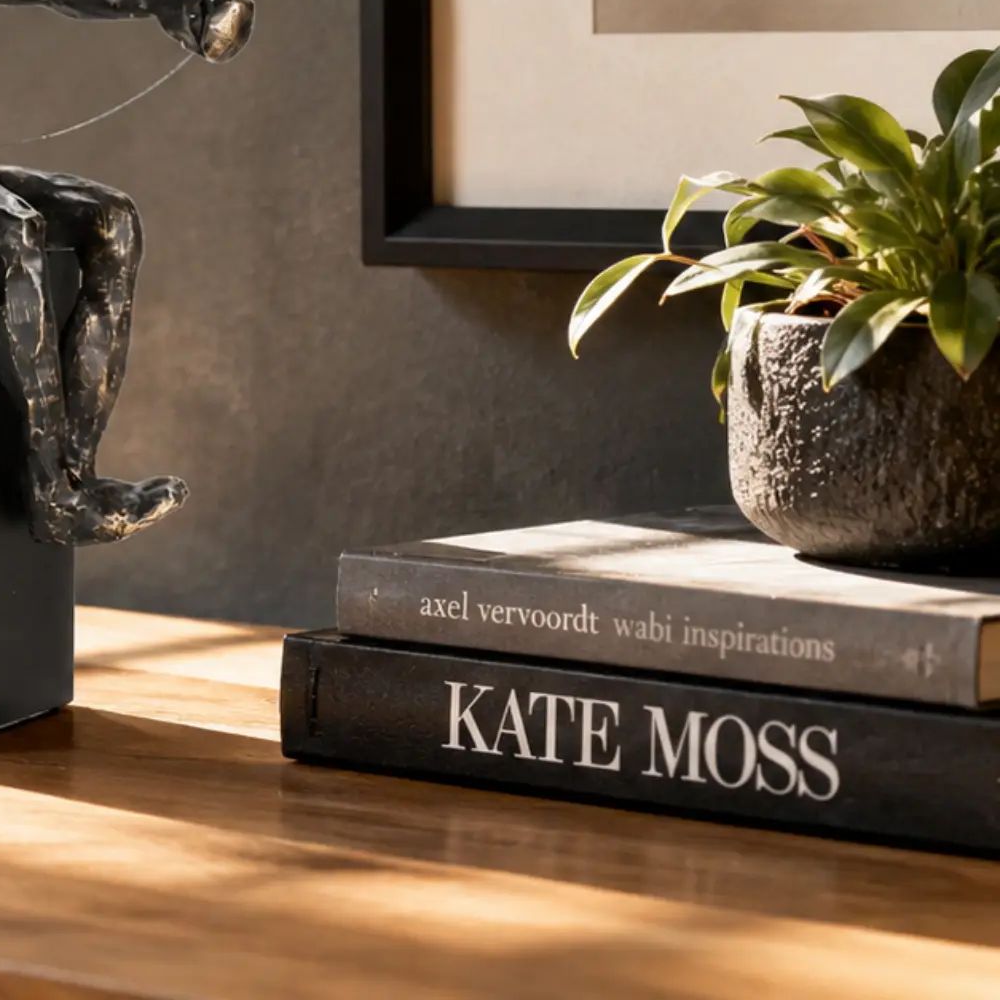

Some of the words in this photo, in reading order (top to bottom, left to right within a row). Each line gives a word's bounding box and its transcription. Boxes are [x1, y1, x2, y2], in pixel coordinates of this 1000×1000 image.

[419, 591, 469, 620] axel
[477, 601, 600, 635] vervoordt
[613, 611, 673, 643] wabi
[682, 616, 837, 662] inspirations
[441, 680, 621, 771] KATE
[642, 705, 840, 801] MOSS
